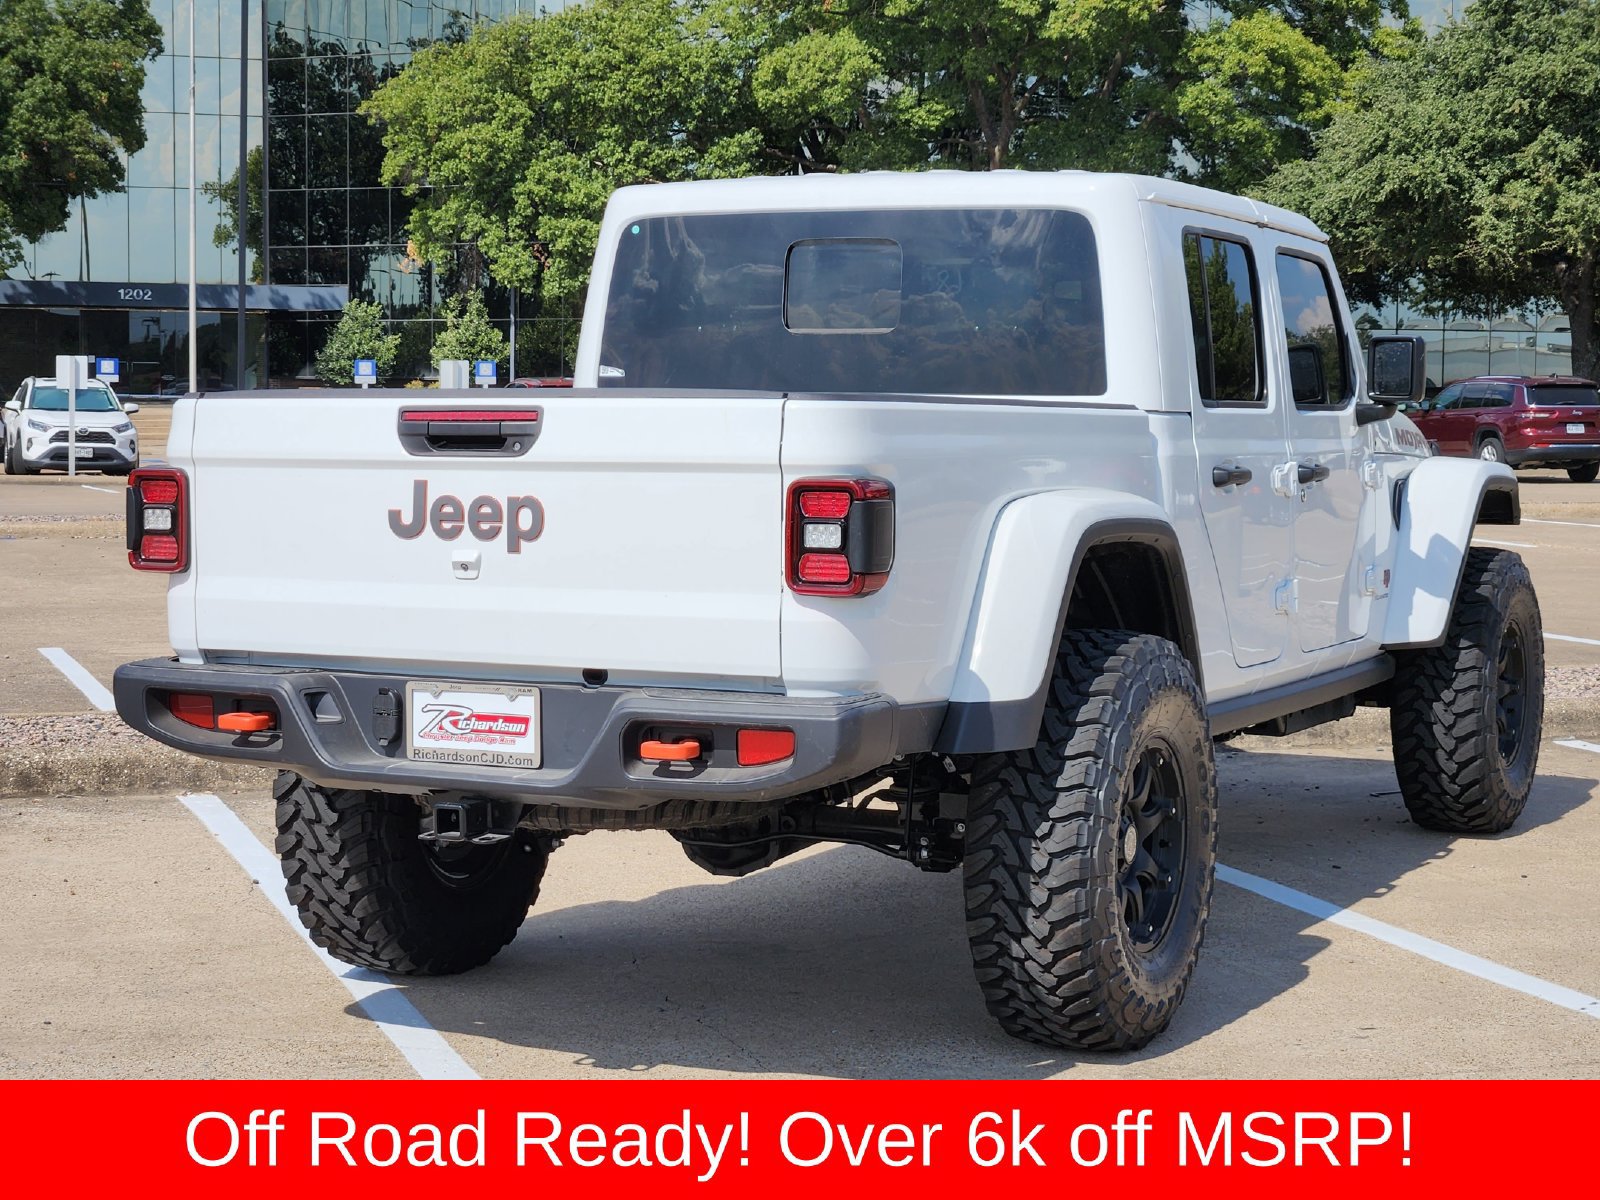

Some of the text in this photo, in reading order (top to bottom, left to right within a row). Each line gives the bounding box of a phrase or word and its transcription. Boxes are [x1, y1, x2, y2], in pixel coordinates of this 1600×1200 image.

[117, 288, 152, 301] 1202
[387, 479, 546, 554] Jeep
[418, 703, 526, 738] Richardson
[412, 748, 534, 767] RichardsonCJD.com
